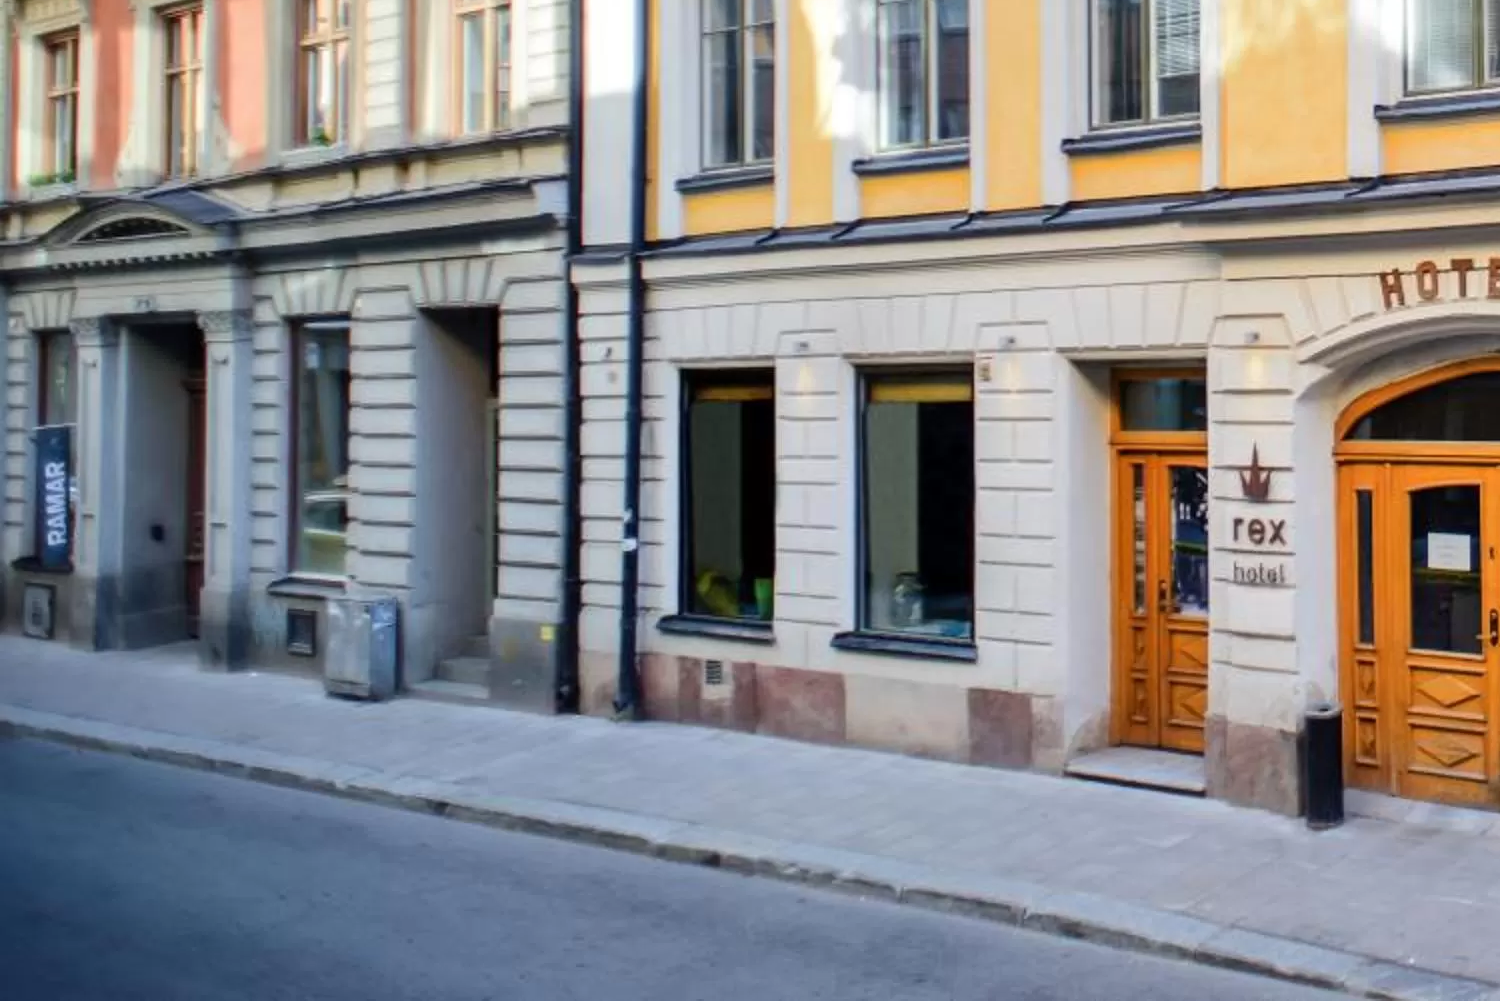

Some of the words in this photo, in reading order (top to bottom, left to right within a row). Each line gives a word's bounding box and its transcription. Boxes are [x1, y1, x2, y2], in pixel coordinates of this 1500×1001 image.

[44, 461, 67, 547] RAMAR
[1233, 517, 1287, 546] rex
[1233, 561, 1286, 584] hotel
